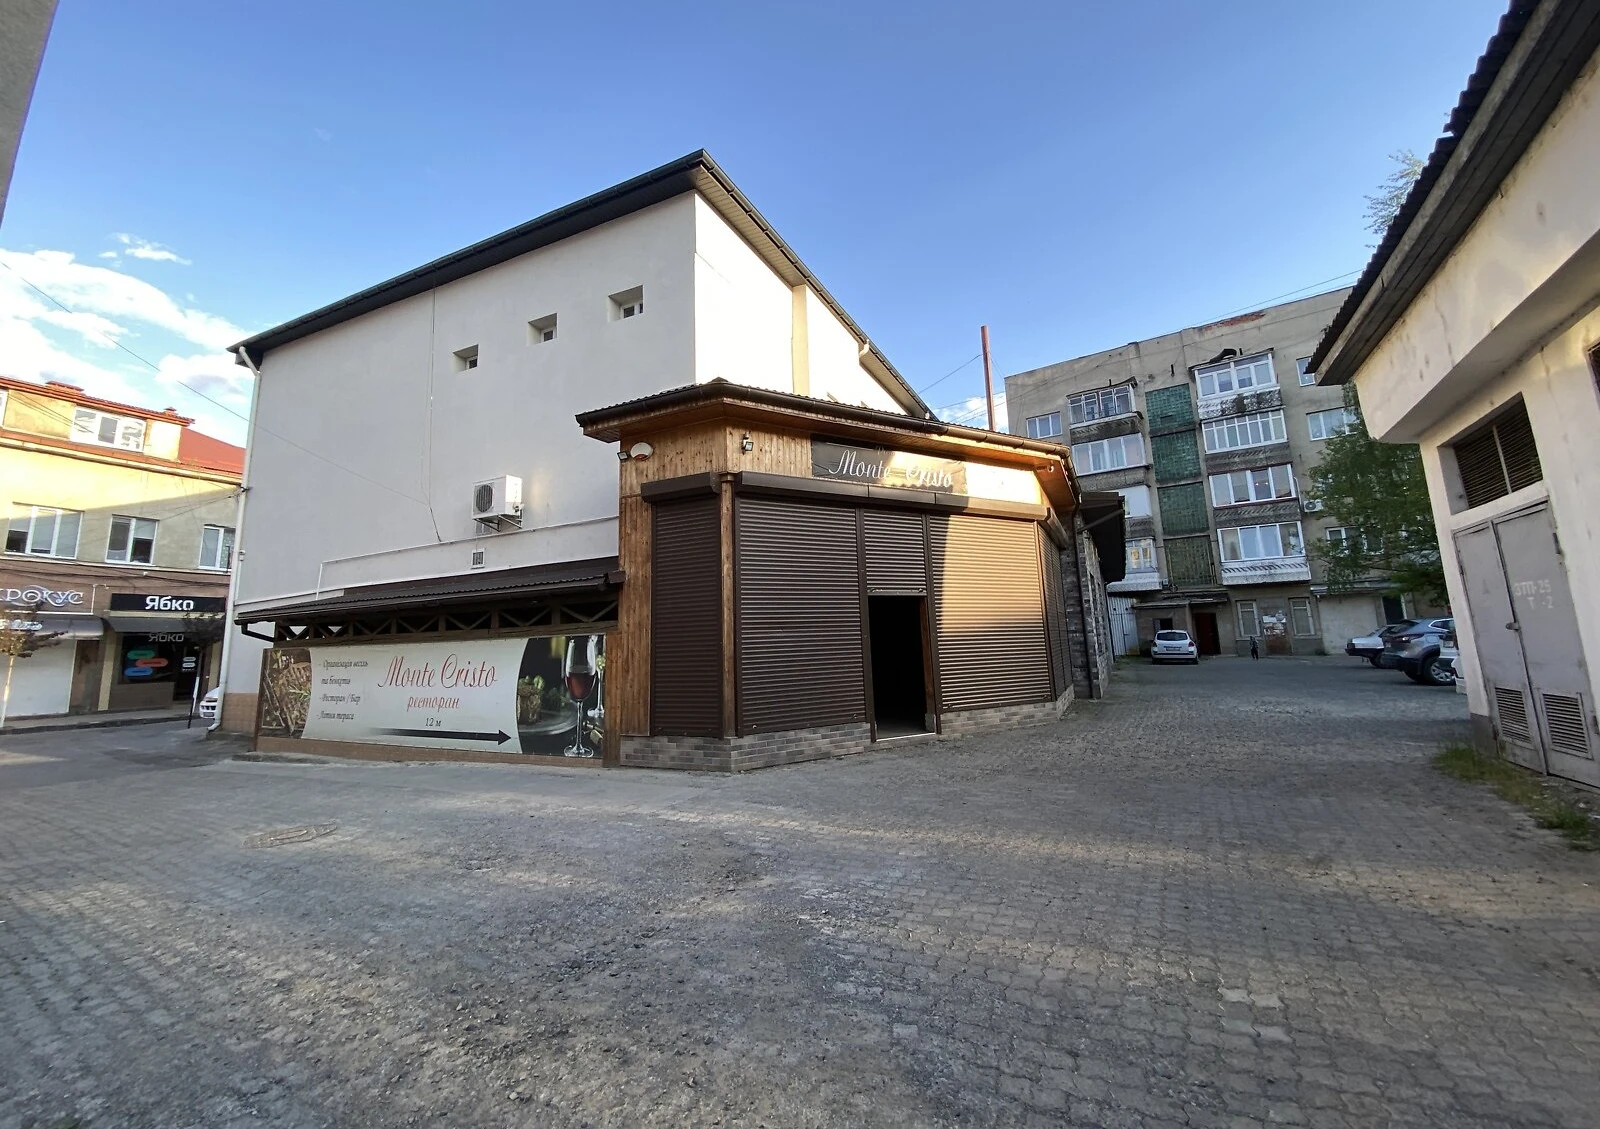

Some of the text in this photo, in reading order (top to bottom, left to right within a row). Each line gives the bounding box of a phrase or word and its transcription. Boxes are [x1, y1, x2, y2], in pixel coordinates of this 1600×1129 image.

[828, 449, 894, 480] Monte
[905, 463, 954, 488] Cristo
[144, 595, 194, 611] Ябко
[377, 653, 499, 689] Monte Cristo
[406, 696, 461, 712] ресторан
[425, 717, 435, 728] 12
